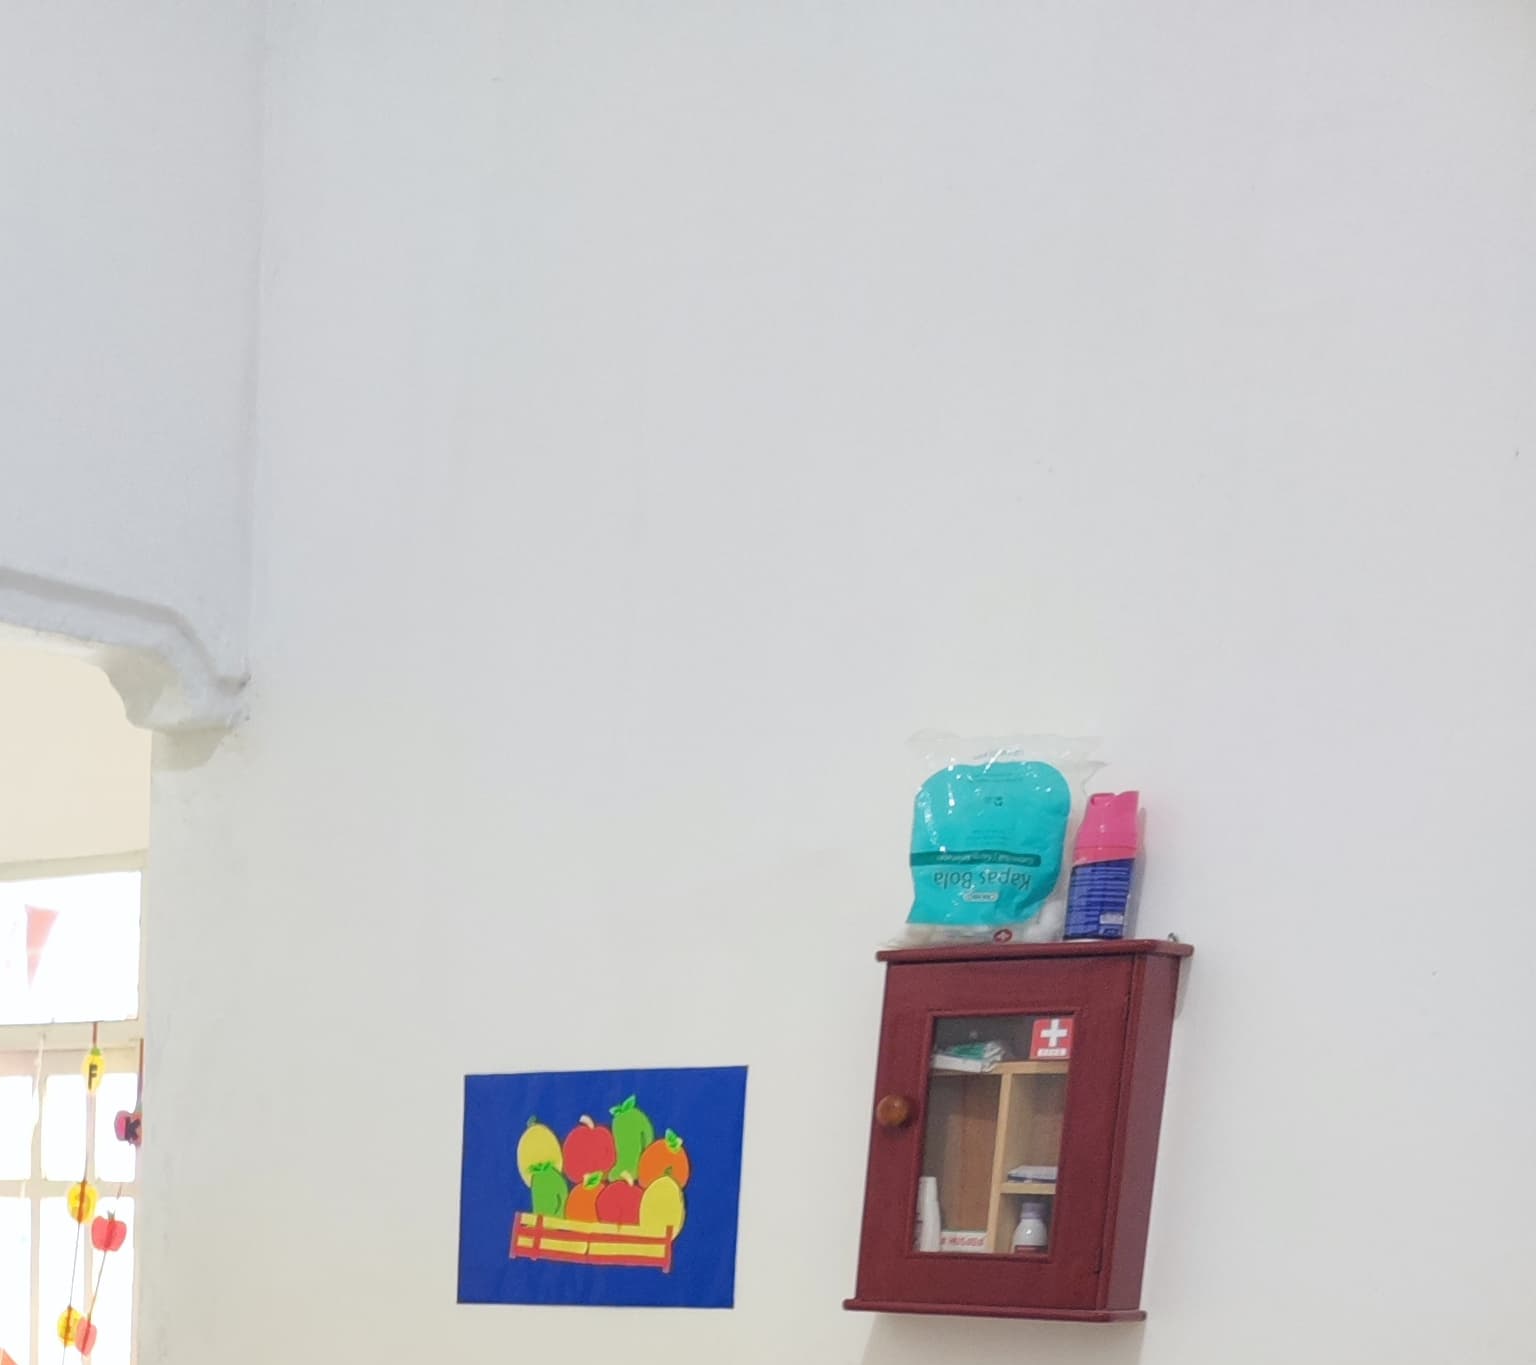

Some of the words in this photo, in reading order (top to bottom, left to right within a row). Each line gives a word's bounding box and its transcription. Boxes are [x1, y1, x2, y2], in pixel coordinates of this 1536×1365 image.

[934, 871, 973, 889] Bola
[979, 868, 1031, 890] Kapas
[88, 1063, 98, 1090] F
